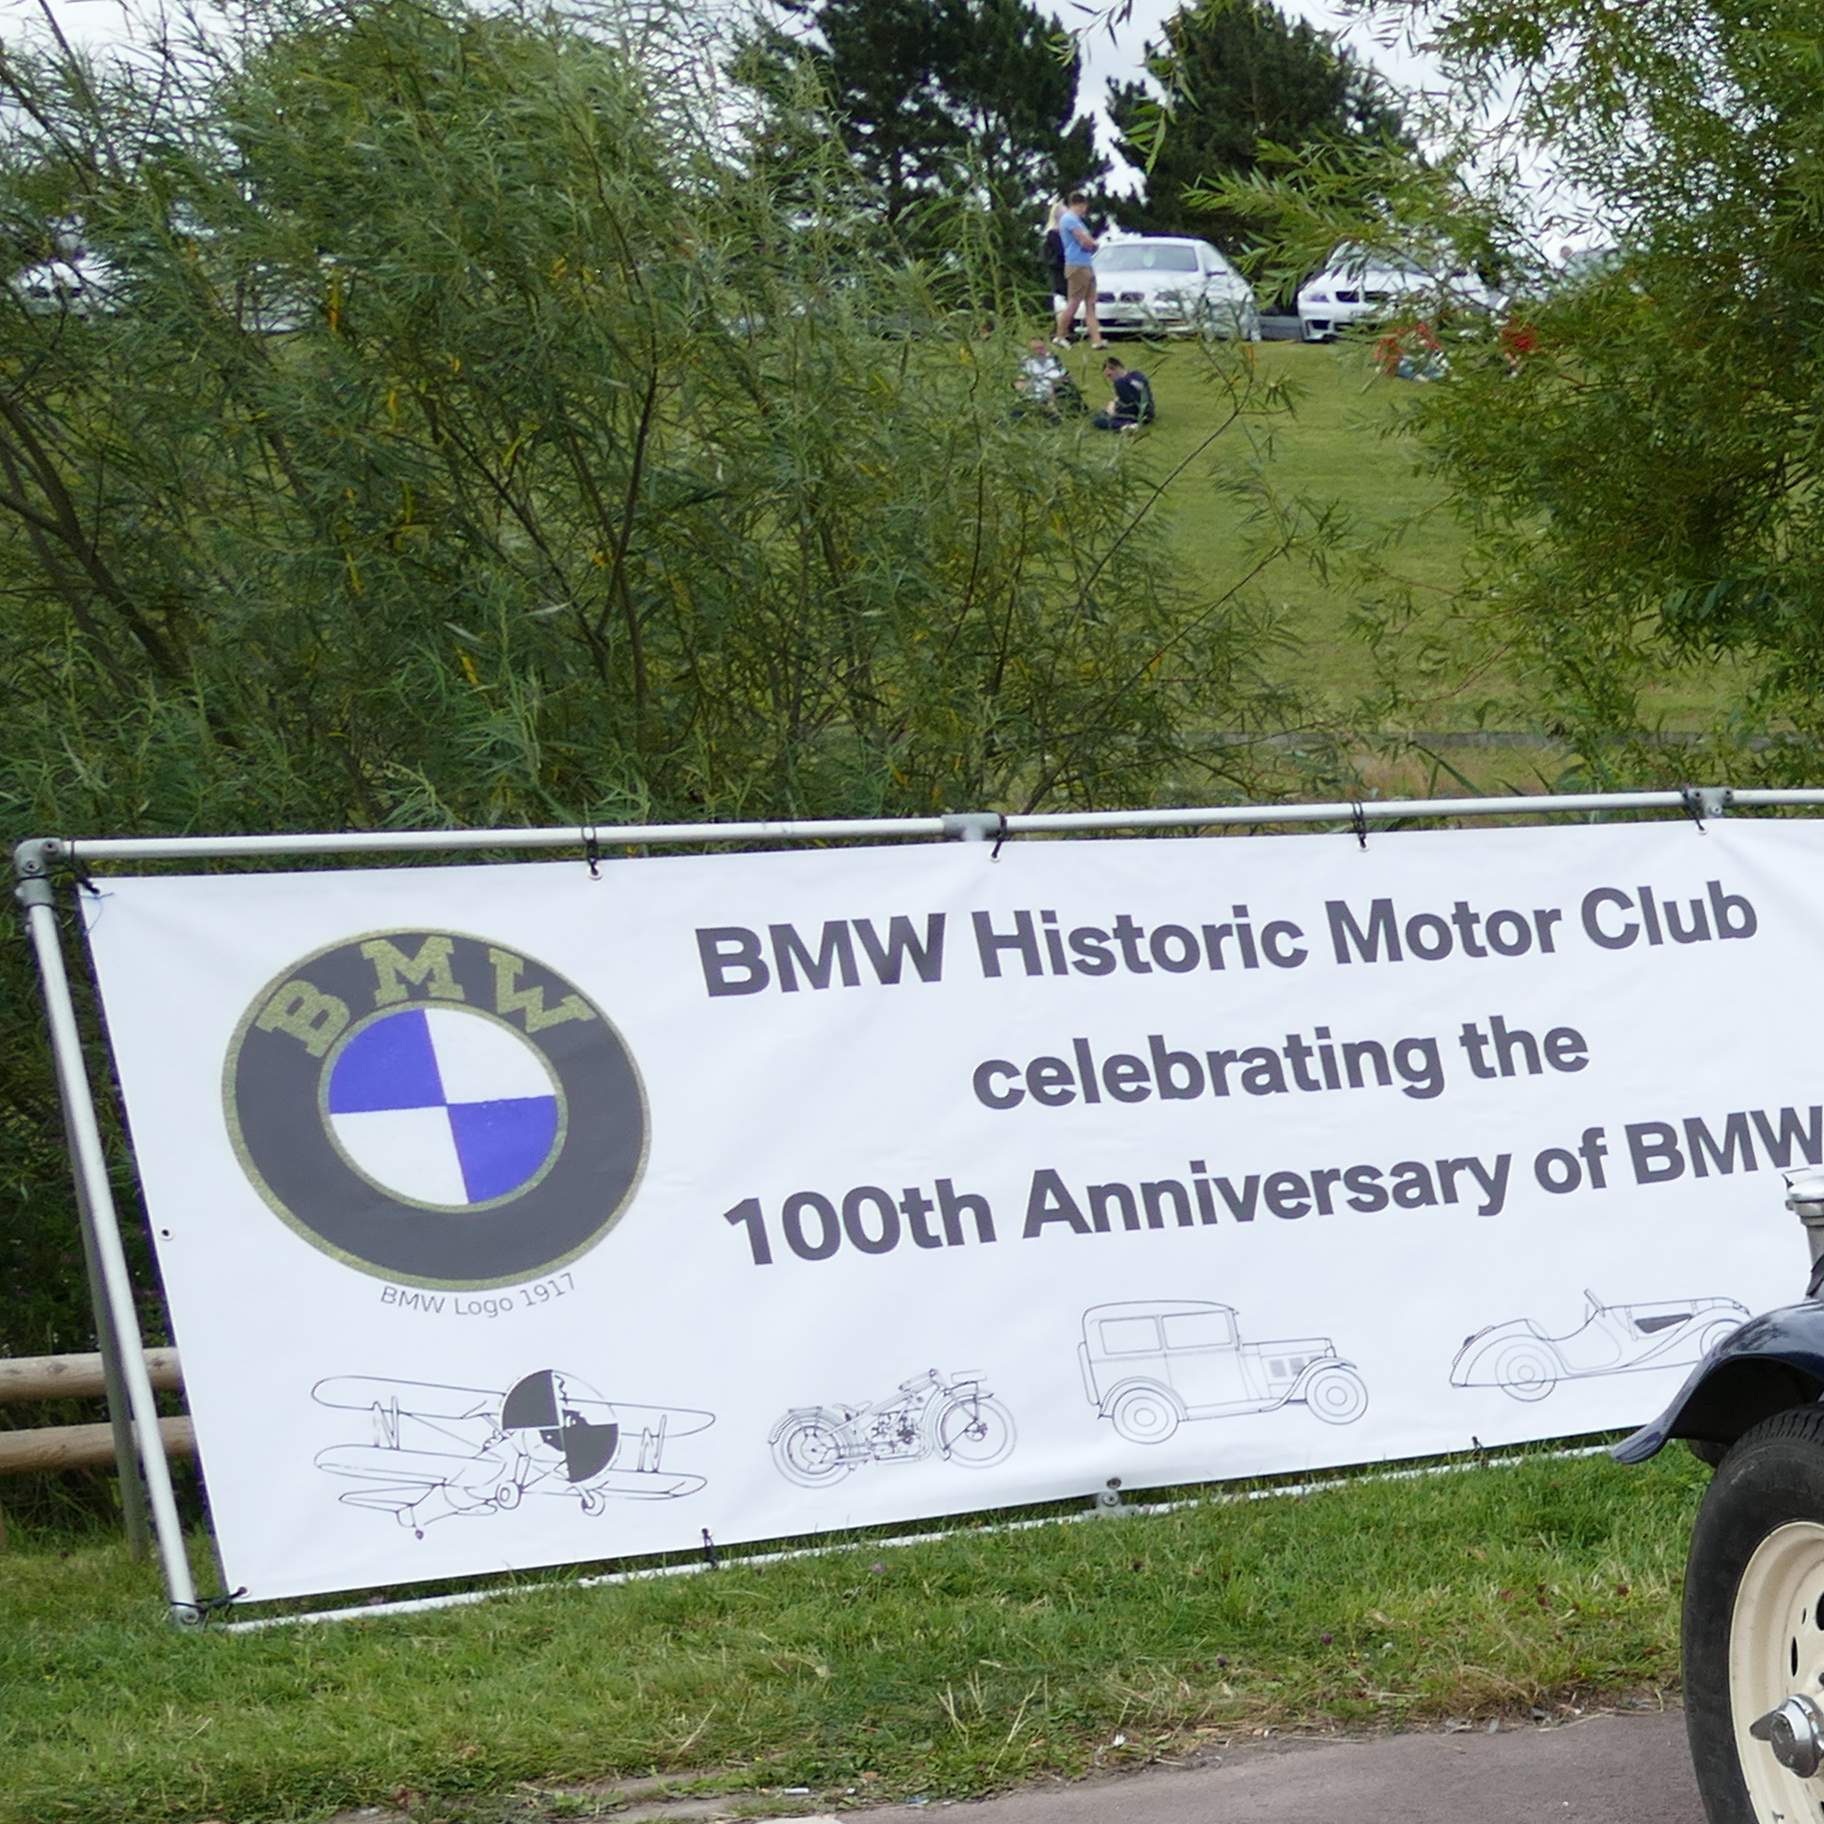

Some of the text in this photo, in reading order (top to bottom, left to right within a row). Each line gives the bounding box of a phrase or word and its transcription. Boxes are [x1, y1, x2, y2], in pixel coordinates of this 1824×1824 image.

[254, 935, 598, 1059] BMW
[695, 880, 1758, 997] BMW Historic Motor Club
[973, 1014, 1590, 1111] celebrating the
[723, 1104, 1824, 1266] 100th Anniversary of BMW
[380, 1271, 576, 1319] BMW Logo 1917
